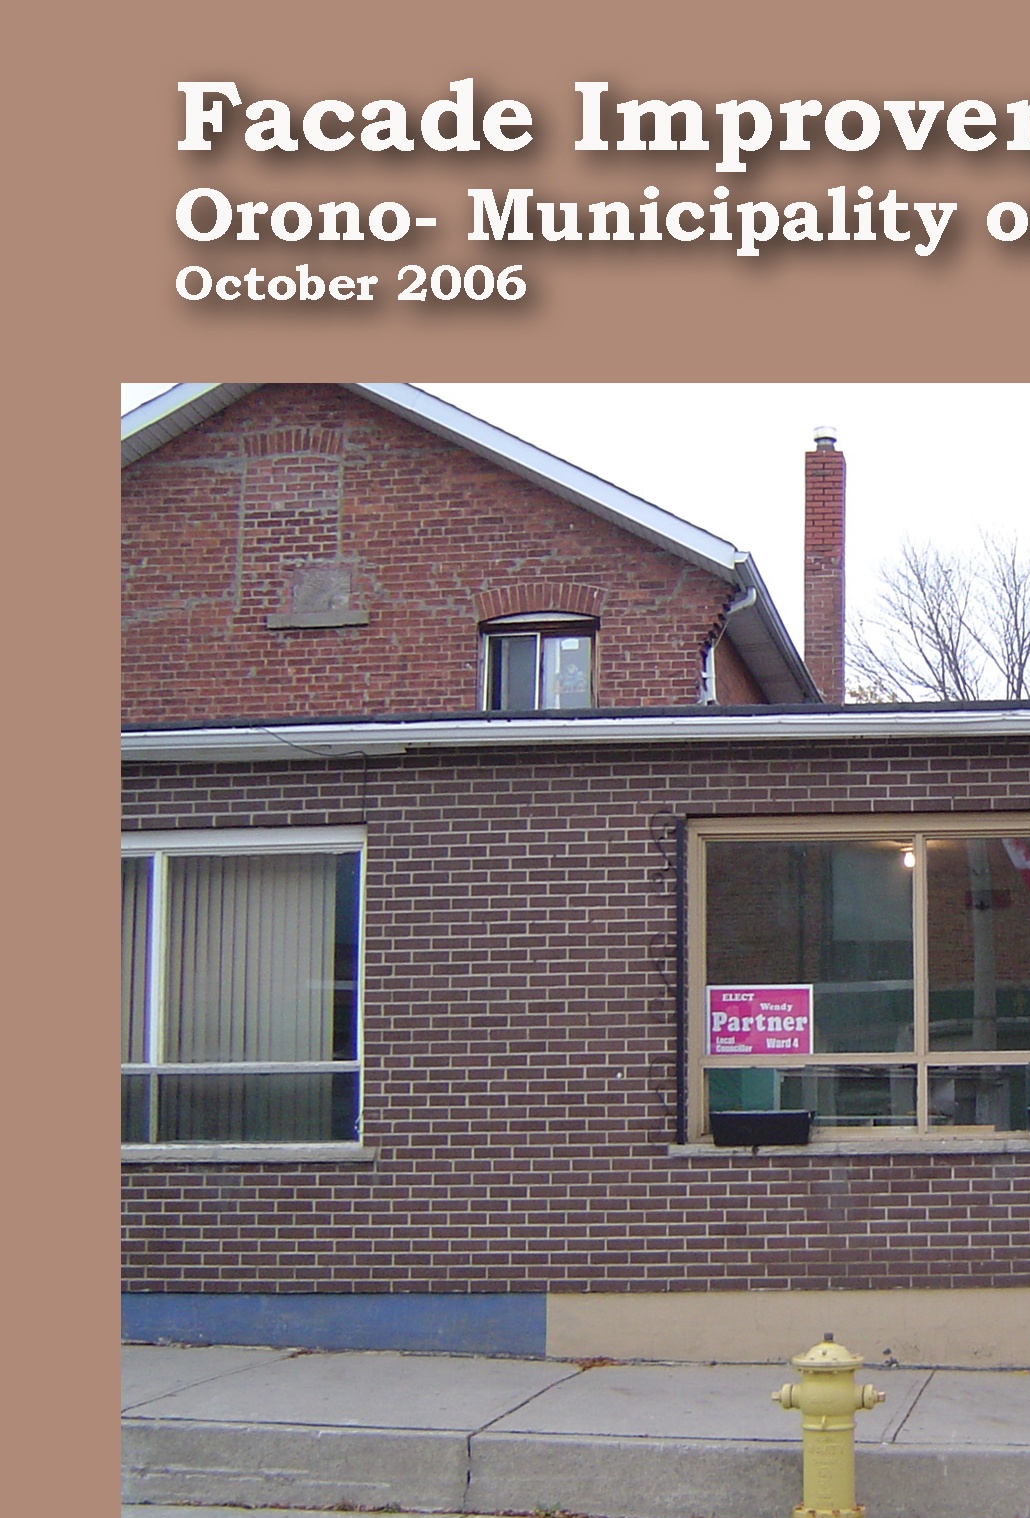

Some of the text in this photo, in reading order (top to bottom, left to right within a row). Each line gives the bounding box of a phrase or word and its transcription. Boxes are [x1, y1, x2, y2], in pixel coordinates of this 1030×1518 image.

[722, 993, 755, 1002] ELECT
[760, 1003, 793, 1012] Wendy
[712, 1012, 808, 1032] Partner
[716, 1036, 735, 1045] Local
[766, 1038, 799, 1048] Ward 4
